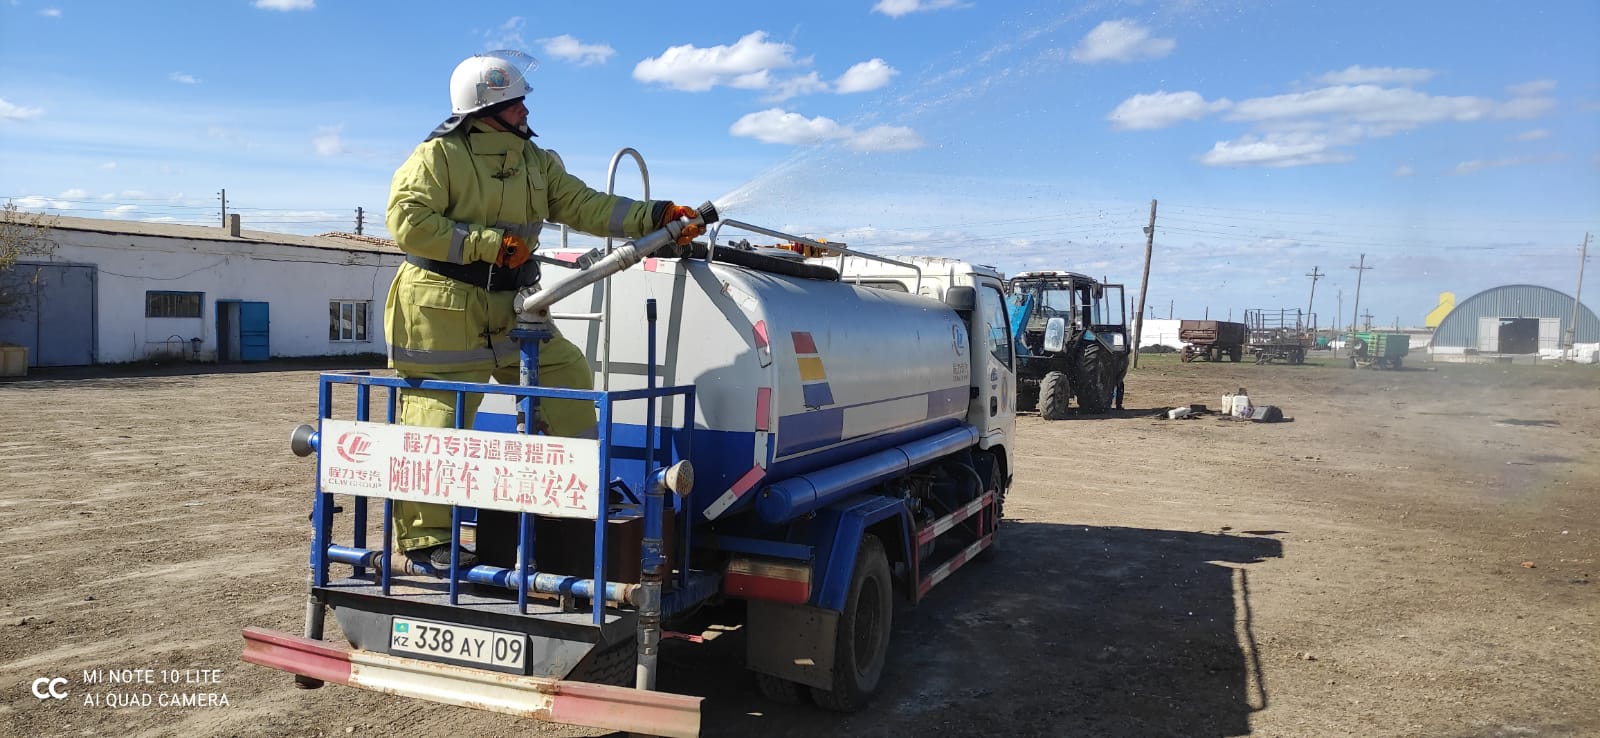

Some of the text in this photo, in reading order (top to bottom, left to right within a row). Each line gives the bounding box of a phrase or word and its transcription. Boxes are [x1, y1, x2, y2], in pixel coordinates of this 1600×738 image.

[328, 478, 382, 488] CLW GROUP
[389, 456, 587, 510] 随时停车 注意安全
[393, 624, 522, 663] KZ 338 AY 09
